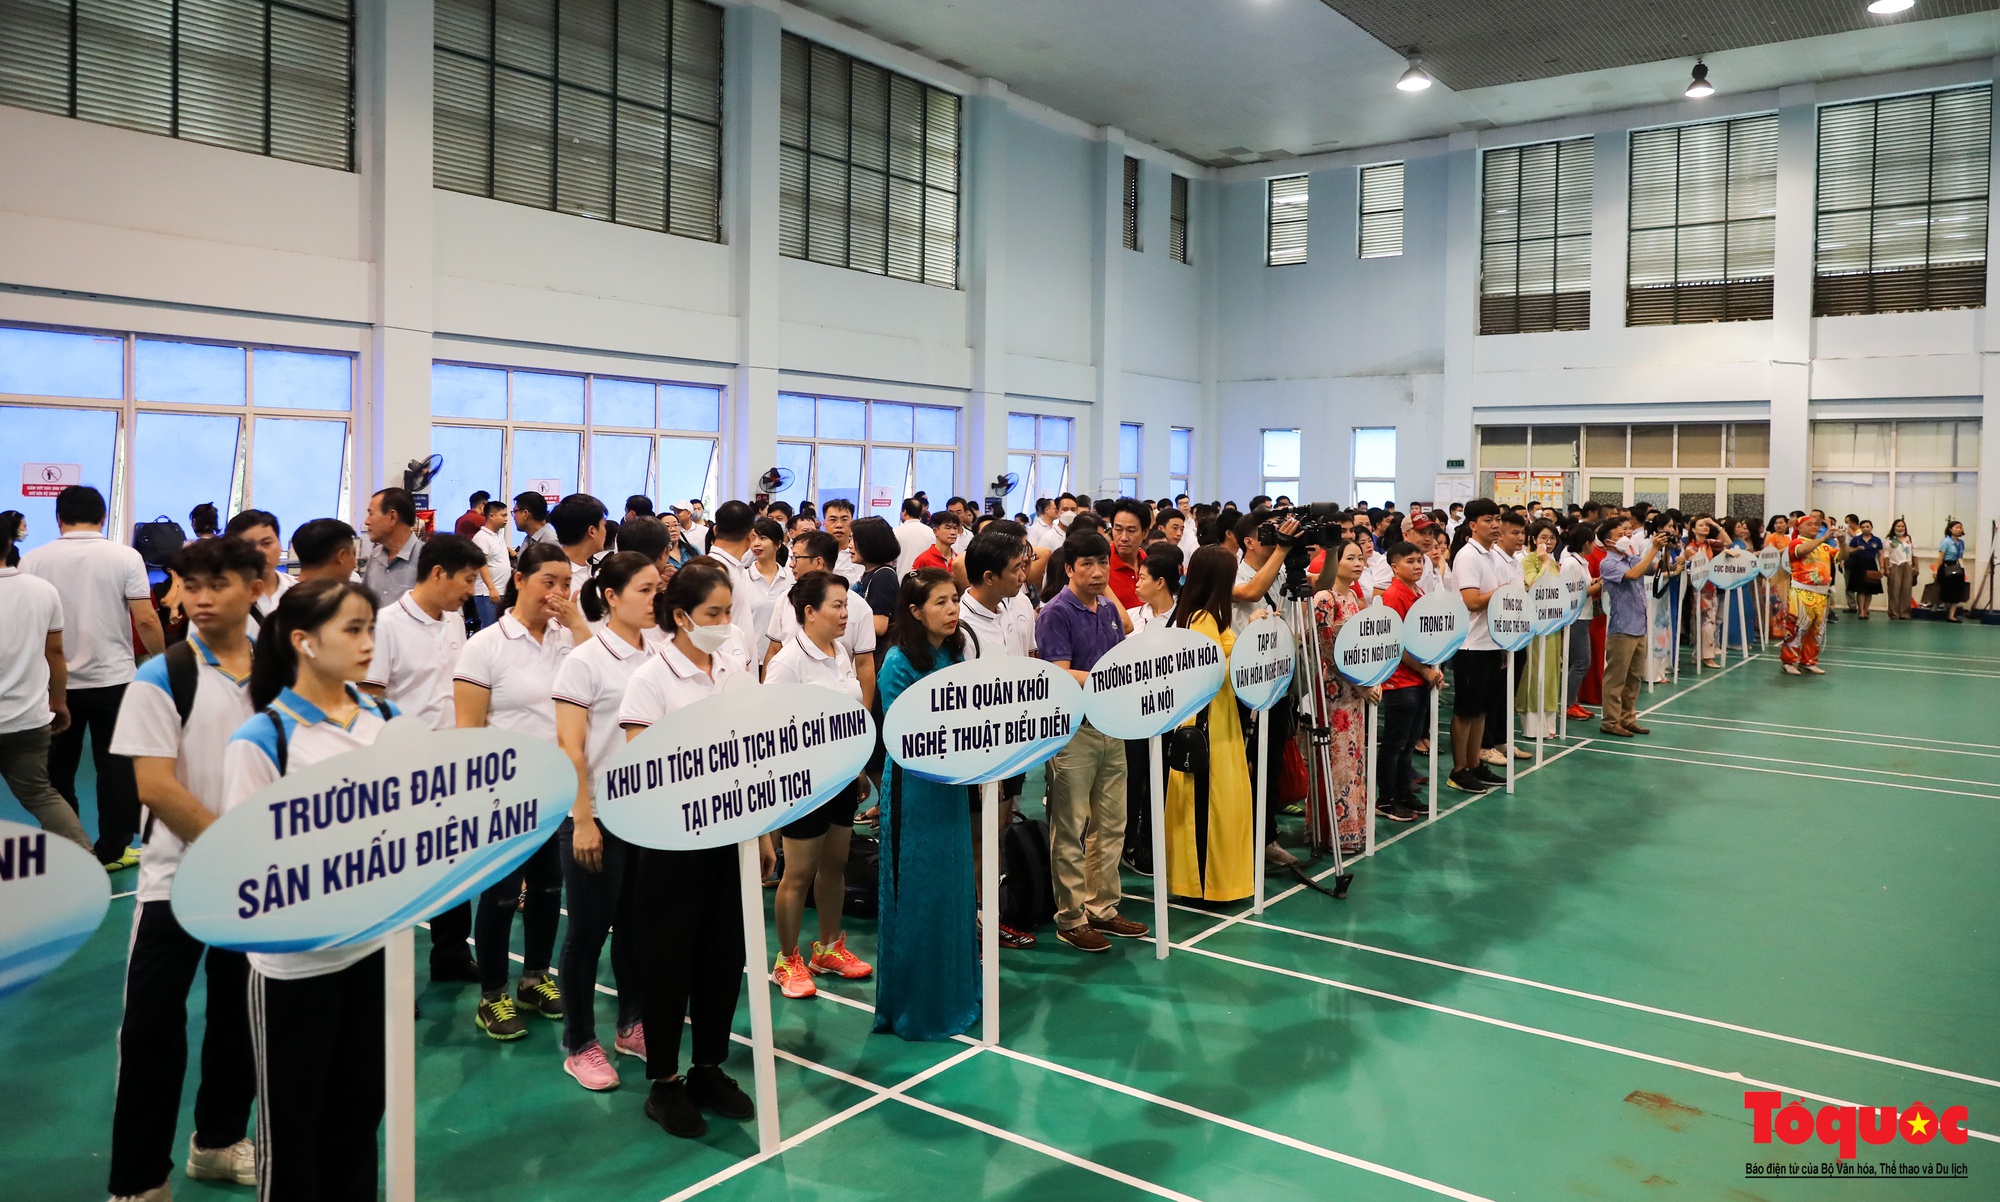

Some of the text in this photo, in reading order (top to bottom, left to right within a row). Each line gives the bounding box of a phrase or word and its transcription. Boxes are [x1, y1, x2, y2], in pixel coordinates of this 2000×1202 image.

[1360, 616, 1392, 637] LIÊN QUÂN
[1420, 611, 1455, 636] TRỌNG TÀI
[1548, 607, 1563, 619] MINH
[1257, 628, 1278, 655] TẠP CHÍ
[1343, 643, 1360, 666] KHỐI
[1361, 647, 1370, 663] 51
[1371, 643, 1384, 662] NGÔ
[1091, 642, 1219, 693] TRƯỜNG ĐẠI HỌC VĂN HÓA
[1235, 666, 1249, 689] VĂN
[1250, 662, 1263, 685] HÓA
[930, 670, 1049, 712] LIÊN QUÂN KHỐI
[1141, 686, 1175, 716] HÀ NỘI
[902, 707, 1071, 760] NGHỆ THUẬT BIỂU DIỄN
[606, 708, 867, 801] KHU DI TÍCH CHỦ TỊCH HỒ CHÍ MINH
[269, 748, 517, 840] TRƯỜNG ĐẠI HỌC
[682, 769, 812, 836] TẠI PHỦ CHỦ TỊCH
[237, 798, 539, 920] SÂN KHẤU ĐIỆN ẢNH
